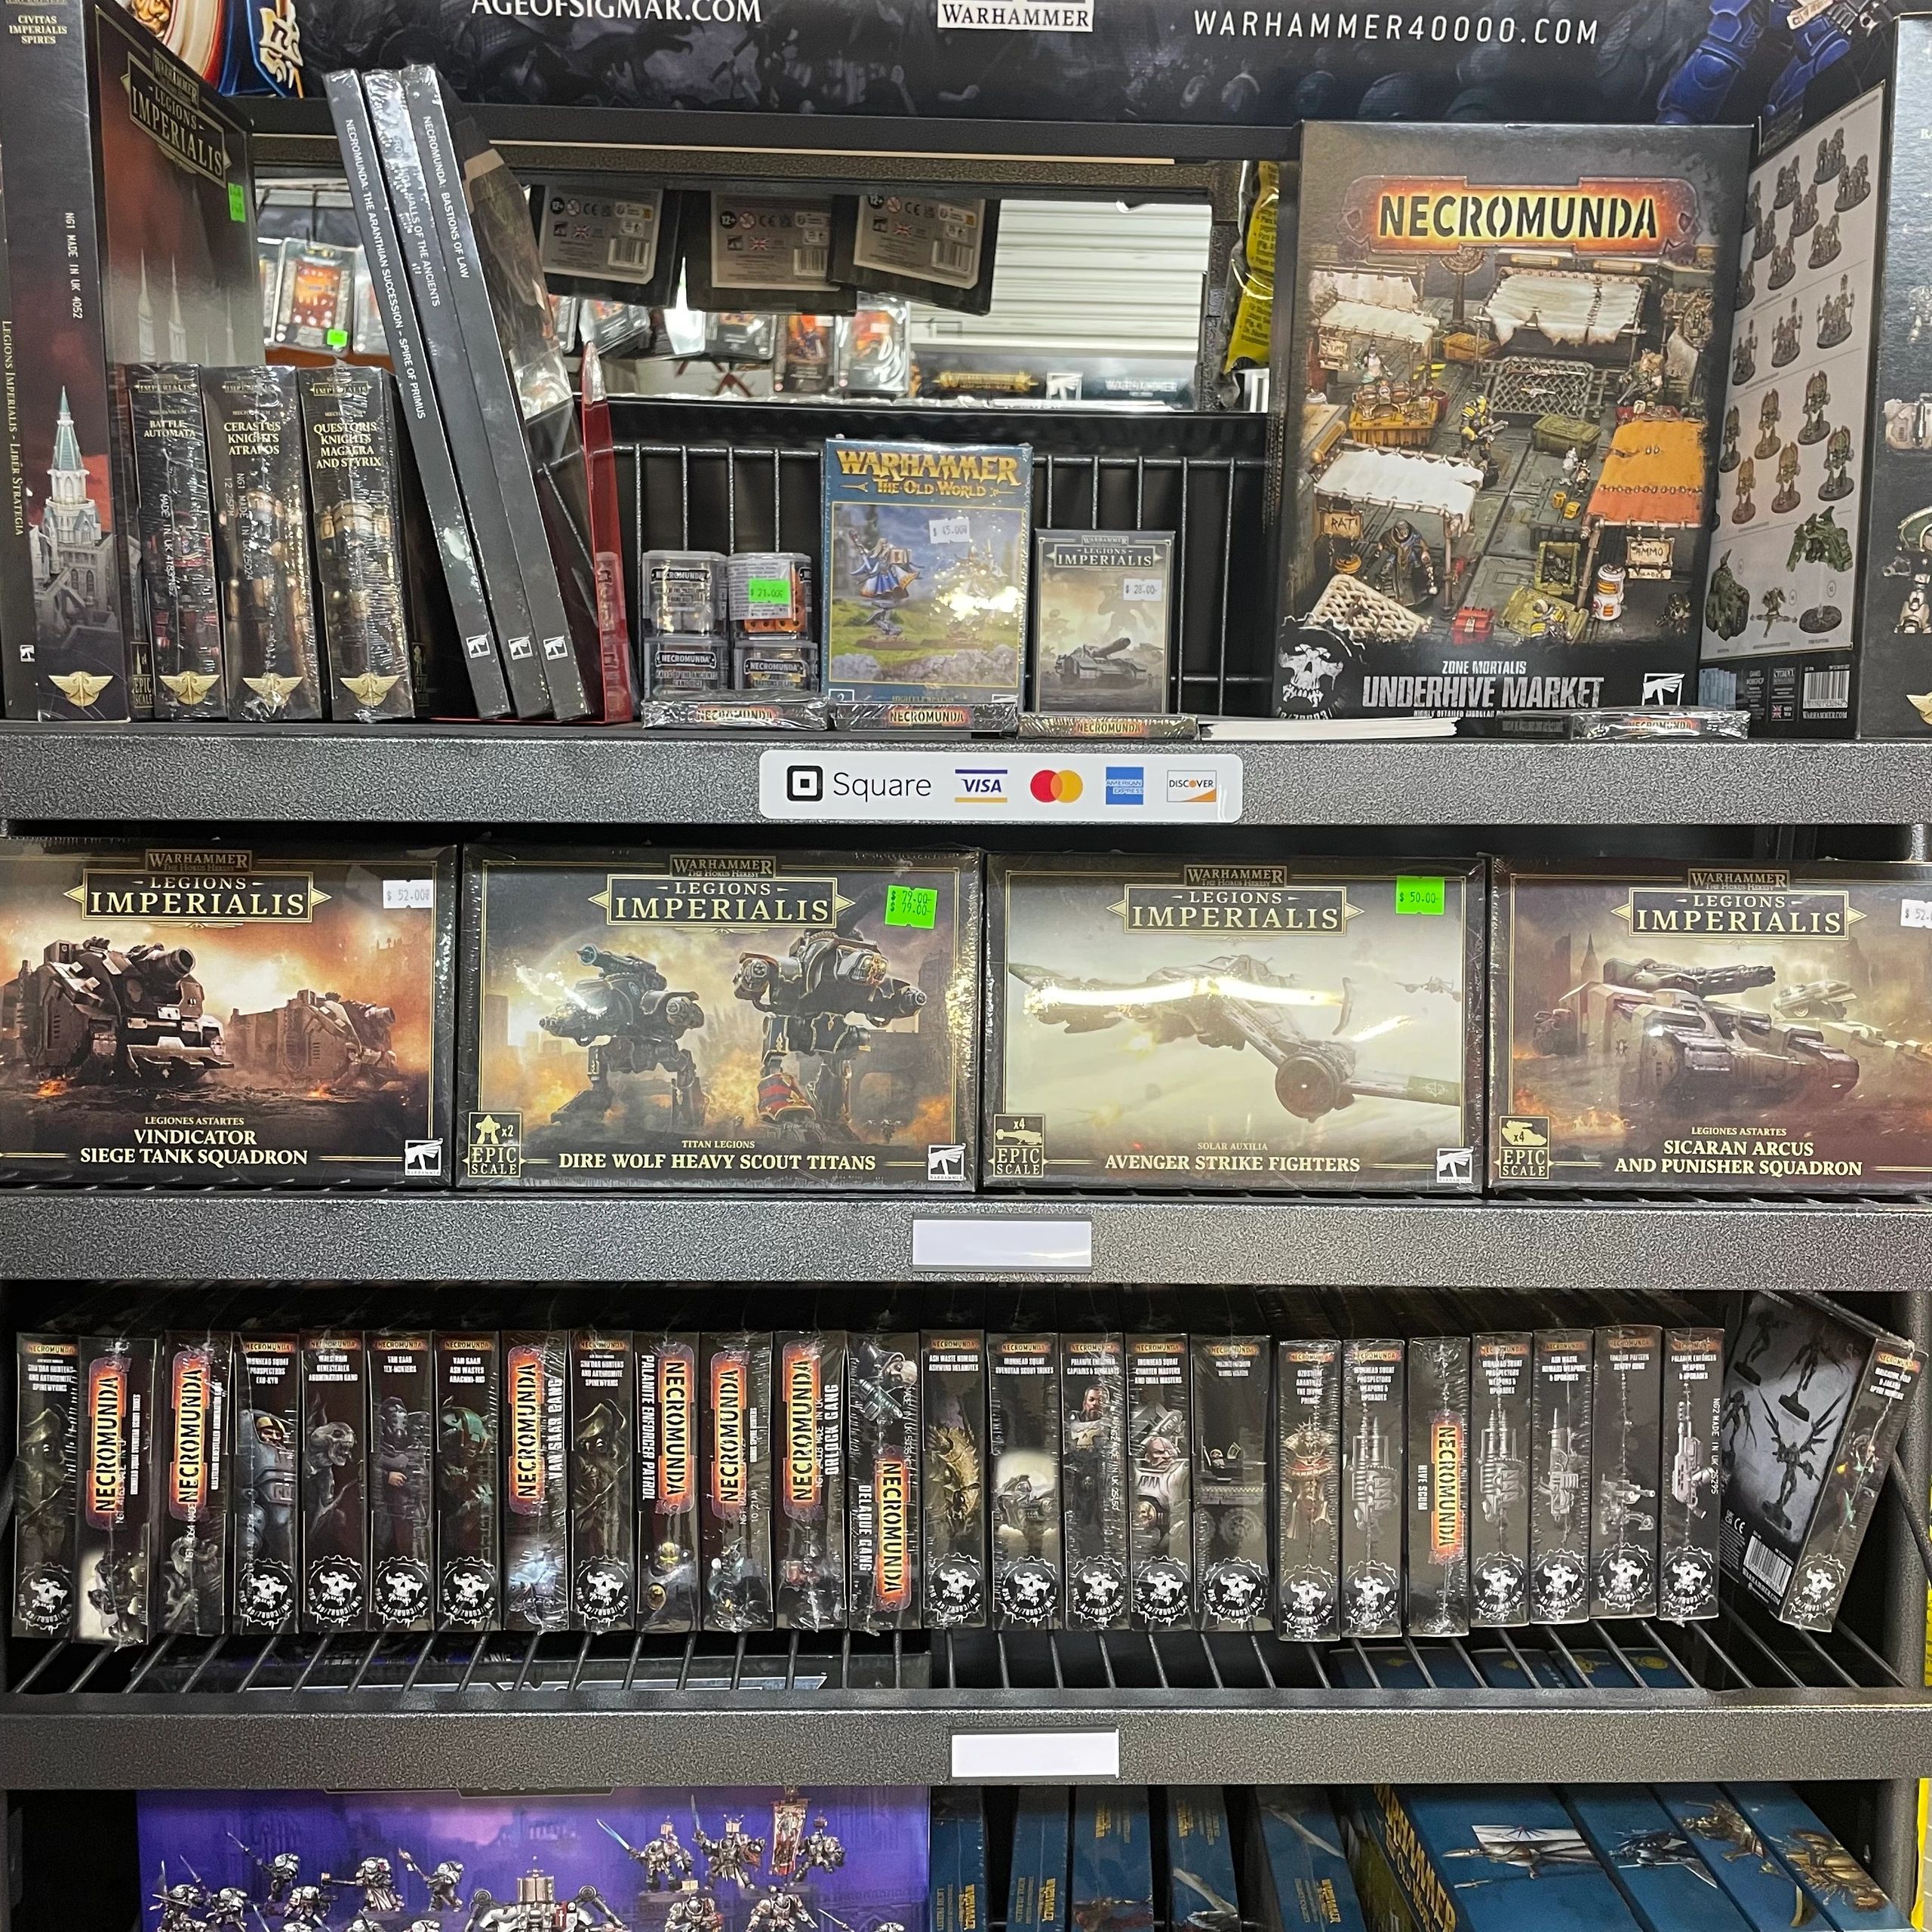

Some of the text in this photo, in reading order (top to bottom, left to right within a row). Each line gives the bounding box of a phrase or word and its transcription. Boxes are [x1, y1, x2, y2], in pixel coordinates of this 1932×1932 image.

[17, 15, 57, 24] CIVITAS
[471, 0, 762, 23] AGEOFSIGMAR.COM
[942, 4, 1090, 28] WARHAMMER
[8, 25, 68, 35] IMPERIALIS
[1193, 9, 1598, 45] WARHAMMER40000.COM
[20, 35, 57, 45] SPIRES
[154, 51, 198, 104] WARHAMMER
[154, 89, 198, 131] LEGIONS
[131, 86, 223, 176] IMPERIALIS
[423, 115, 470, 279] NECROMUNDA: BASTIONS OF LAW
[1379, 195, 1658, 239] NECROMUNDA
[66, 233, 78, 258] MADE
[407, 193, 441, 307] HALLS OF THE ANCIENTS
[69, 262, 79, 276] IN
[346, 118, 426, 419] NECROMUNDA: THE ARANTHIAN SUCCESSION SPIRE OF PRIMUS
[69, 280, 81, 293] UK
[72, 296, 84, 319] 4052
[2, 320, 25, 537] LEGIONS IMPERIALIS LIBER STRATEGIA
[143, 429, 196, 438] AUTOMATA
[149, 420, 186, 430] BATTLE
[223, 422, 281, 432] CERASTUS
[313, 422, 377, 434] QUESTORIS
[320, 433, 372, 445] KNIGHTS
[316, 456, 381, 469] AND STYRIX
[836, 450, 1022, 486] WARHAMMER
[873, 478, 986, 498] THE OLD WORLD
[1082, 535, 1129, 546] WARHAMMER
[1084, 547, 1128, 555] LEGIONS
[1057, 552, 1153, 568] IMPERIALIS
[661, 654, 710, 664] NECROMUNDA
[749, 662, 798, 672] NECROMUNDA
[1441, 660, 1527, 675] ZONE MORTALIS
[1362, 676, 1604, 709] UNDERHIVE MARKET
[889, 709, 965, 724] NECROMUNDA
[1076, 722, 1142, 735] NECROMUNDA
[832, 771, 932, 803] Square
[961, 778, 1002, 794] VISA
[1168, 778, 1215, 789] DISCOVER
[149, 852, 248, 870] WARHAMMER
[673, 857, 774, 875] WARHAMMER
[149, 876, 247, 890] LEGIONS
[1186, 867, 1284, 884] WARHAMMER
[1691, 871, 1786, 888] WARHAMMER
[675, 882, 771, 896] LEGIONS
[1189, 891, 1282, 904] LEGIONS
[91, 891, 304, 916] IMPERIALIS
[615, 897, 829, 922] IMPERIALIS
[1694, 894, 1786, 908] LEGIONS
[1132, 906, 1339, 931] IMPERIALIS
[1637, 909, 1841, 934] IMPERIALIS
[144, 1115, 245, 1127] LEGIONES ASTARTES
[1013, 1118, 1026, 1130] x4
[133, 1129, 257, 1146] VINDICATOR
[501, 1128, 514, 1138] x2
[1512, 1131, 1525, 1144] x4
[1691, 1128, 1787, 1137] LEGIONES ASTARTES
[681, 1140, 755, 1149] TITAN LEGIONS
[1197, 1142, 1269, 1151] SOLAR AUXILIA
[1663, 1140, 1814, 1156] SICARAN ARCUS
[80, 1147, 308, 1168] SIEGE TANK SQUADRON
[471, 1148, 518, 1163] EPIC
[558, 1153, 876, 1171] DIRE WOLF HEAVY SCOUT TITANS
[995, 1147, 1041, 1163] EPIC
[1104, 1154, 1361, 1173] AVENGER STRIKE FIGHTERS
[1503, 1150, 1546, 1165] EPIC
[471, 1164, 518, 1175] SCALE
[995, 1164, 1041, 1175] SCALE
[1503, 1166, 1546, 1177] SCALE
[1614, 1158, 1863, 1178] AND PUNISHER SQUADRON
[377, 1340, 423, 1349] NECROMUNDA
[445, 1340, 489, 1349] NECROMUNDA
[932, 1340, 975, 1349] NECROMUNDA
[1002, 1343, 1047, 1352] NECROMUNDA
[178, 1369, 202, 1503] NECROMUNDA
[517, 1364, 537, 1497] NECROMUNDA
[547, 1377, 563, 1480] VAN SAAR GANG
[641, 1355, 656, 1500] PALANITE ENFORCER PATROL
[666, 1362, 685, 1496] NECROMUNDA
[720, 1369, 739, 1502] NECROMUNDA
[792, 1360, 813, 1500] NECROMUNDA
[824, 1383, 839, 1475] ORLOCK GANG
[95, 1377, 118, 1512] NECROMUNDA
[1710, 1398, 1721, 1495] NG2 MADE IN UK 25295
[1417, 1464, 1428, 1510] HIVE SCUM
[1438, 1426, 1456, 1547] NECROMUNDA
[857, 1484, 873, 1571] DELAQUE GANG
[883, 1463, 903, 1593] NECROMUNDA
